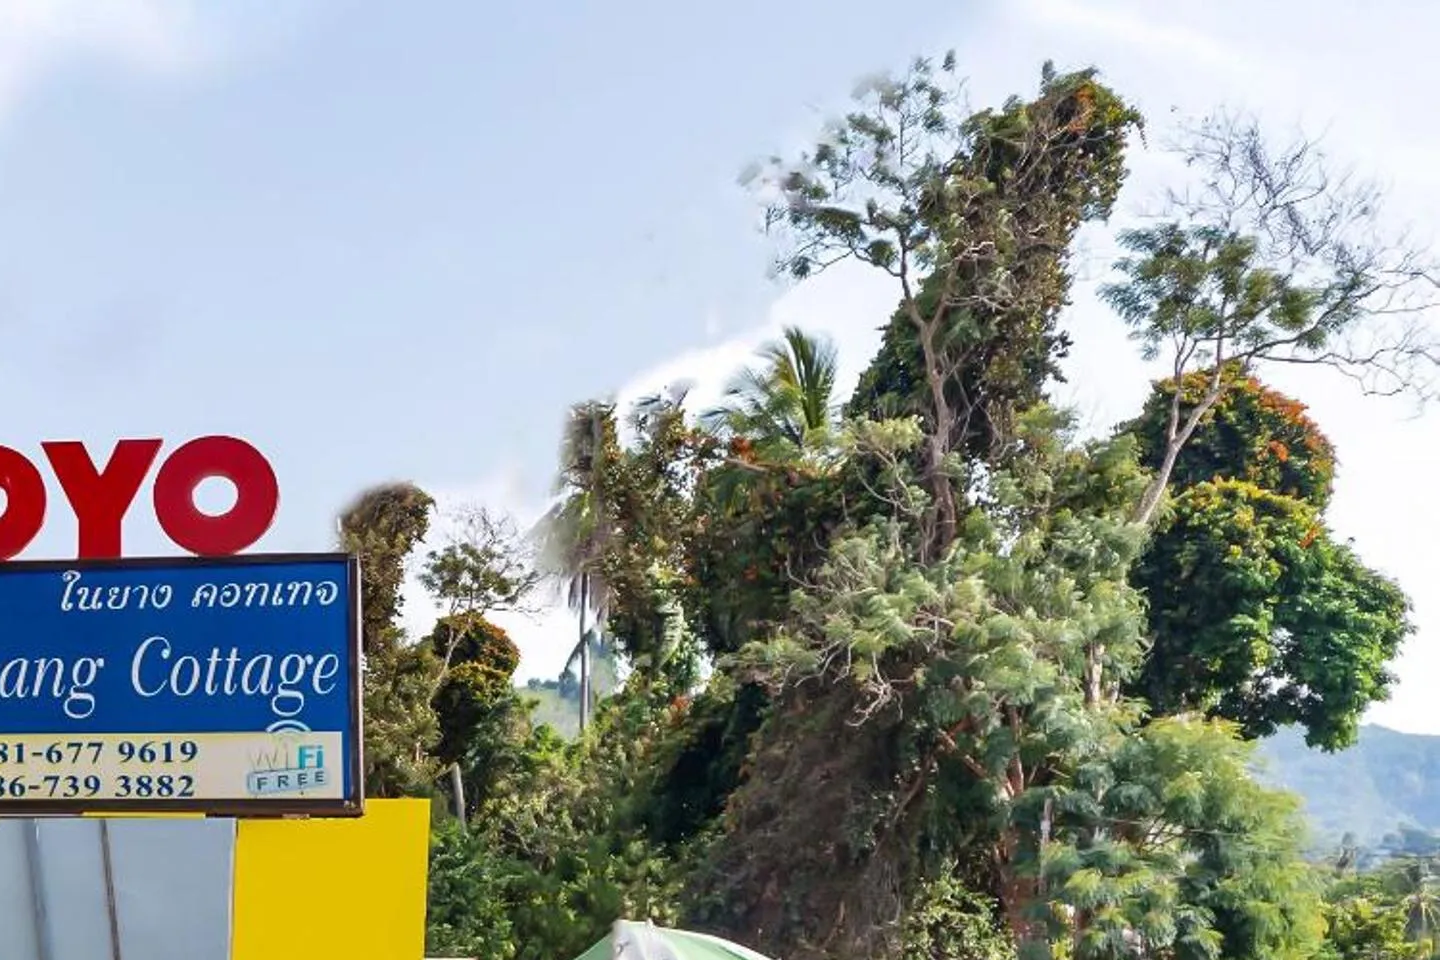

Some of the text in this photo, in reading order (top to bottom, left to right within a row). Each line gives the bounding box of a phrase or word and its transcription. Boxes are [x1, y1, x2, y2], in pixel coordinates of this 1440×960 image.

[60, 569, 339, 611] ในยาง คอทเทจ
[131, 636, 340, 717] Cottage
[118, 740, 198, 763] 9619
[115, 775, 195, 797] 3882
[256, 770, 325, 791] FREE
